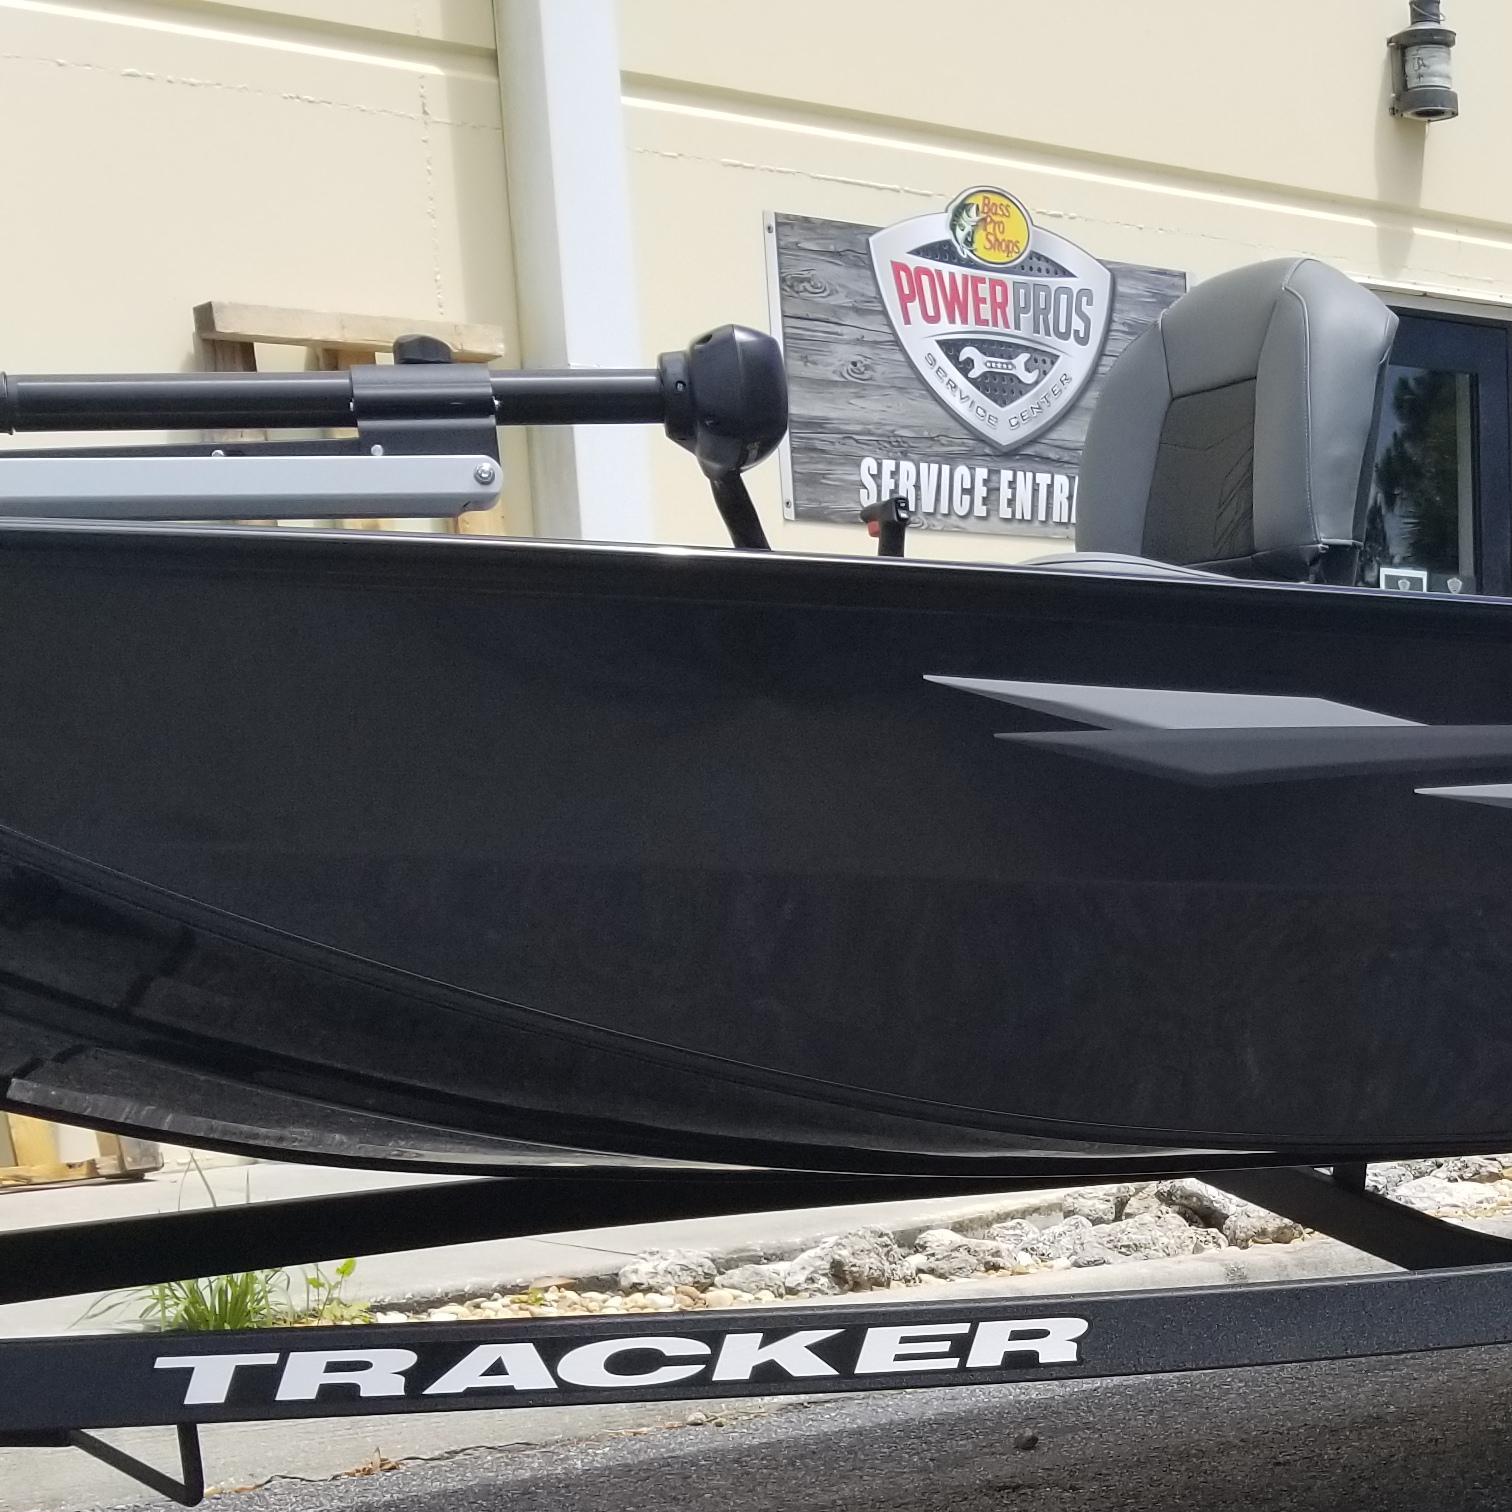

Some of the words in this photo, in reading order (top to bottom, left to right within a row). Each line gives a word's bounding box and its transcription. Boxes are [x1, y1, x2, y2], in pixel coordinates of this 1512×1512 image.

[981, 195, 1011, 218] Bass
[983, 215, 1006, 238] Pro
[984, 232, 1021, 258] Shops
[924, 352, 1000, 426] SERVICE
[1007, 372, 1073, 431] CENTER
[859, 456, 988, 517] SERVICE
[999, 469, 1078, 524] ENTR
[153, 1315, 1090, 1406] TRACKER
